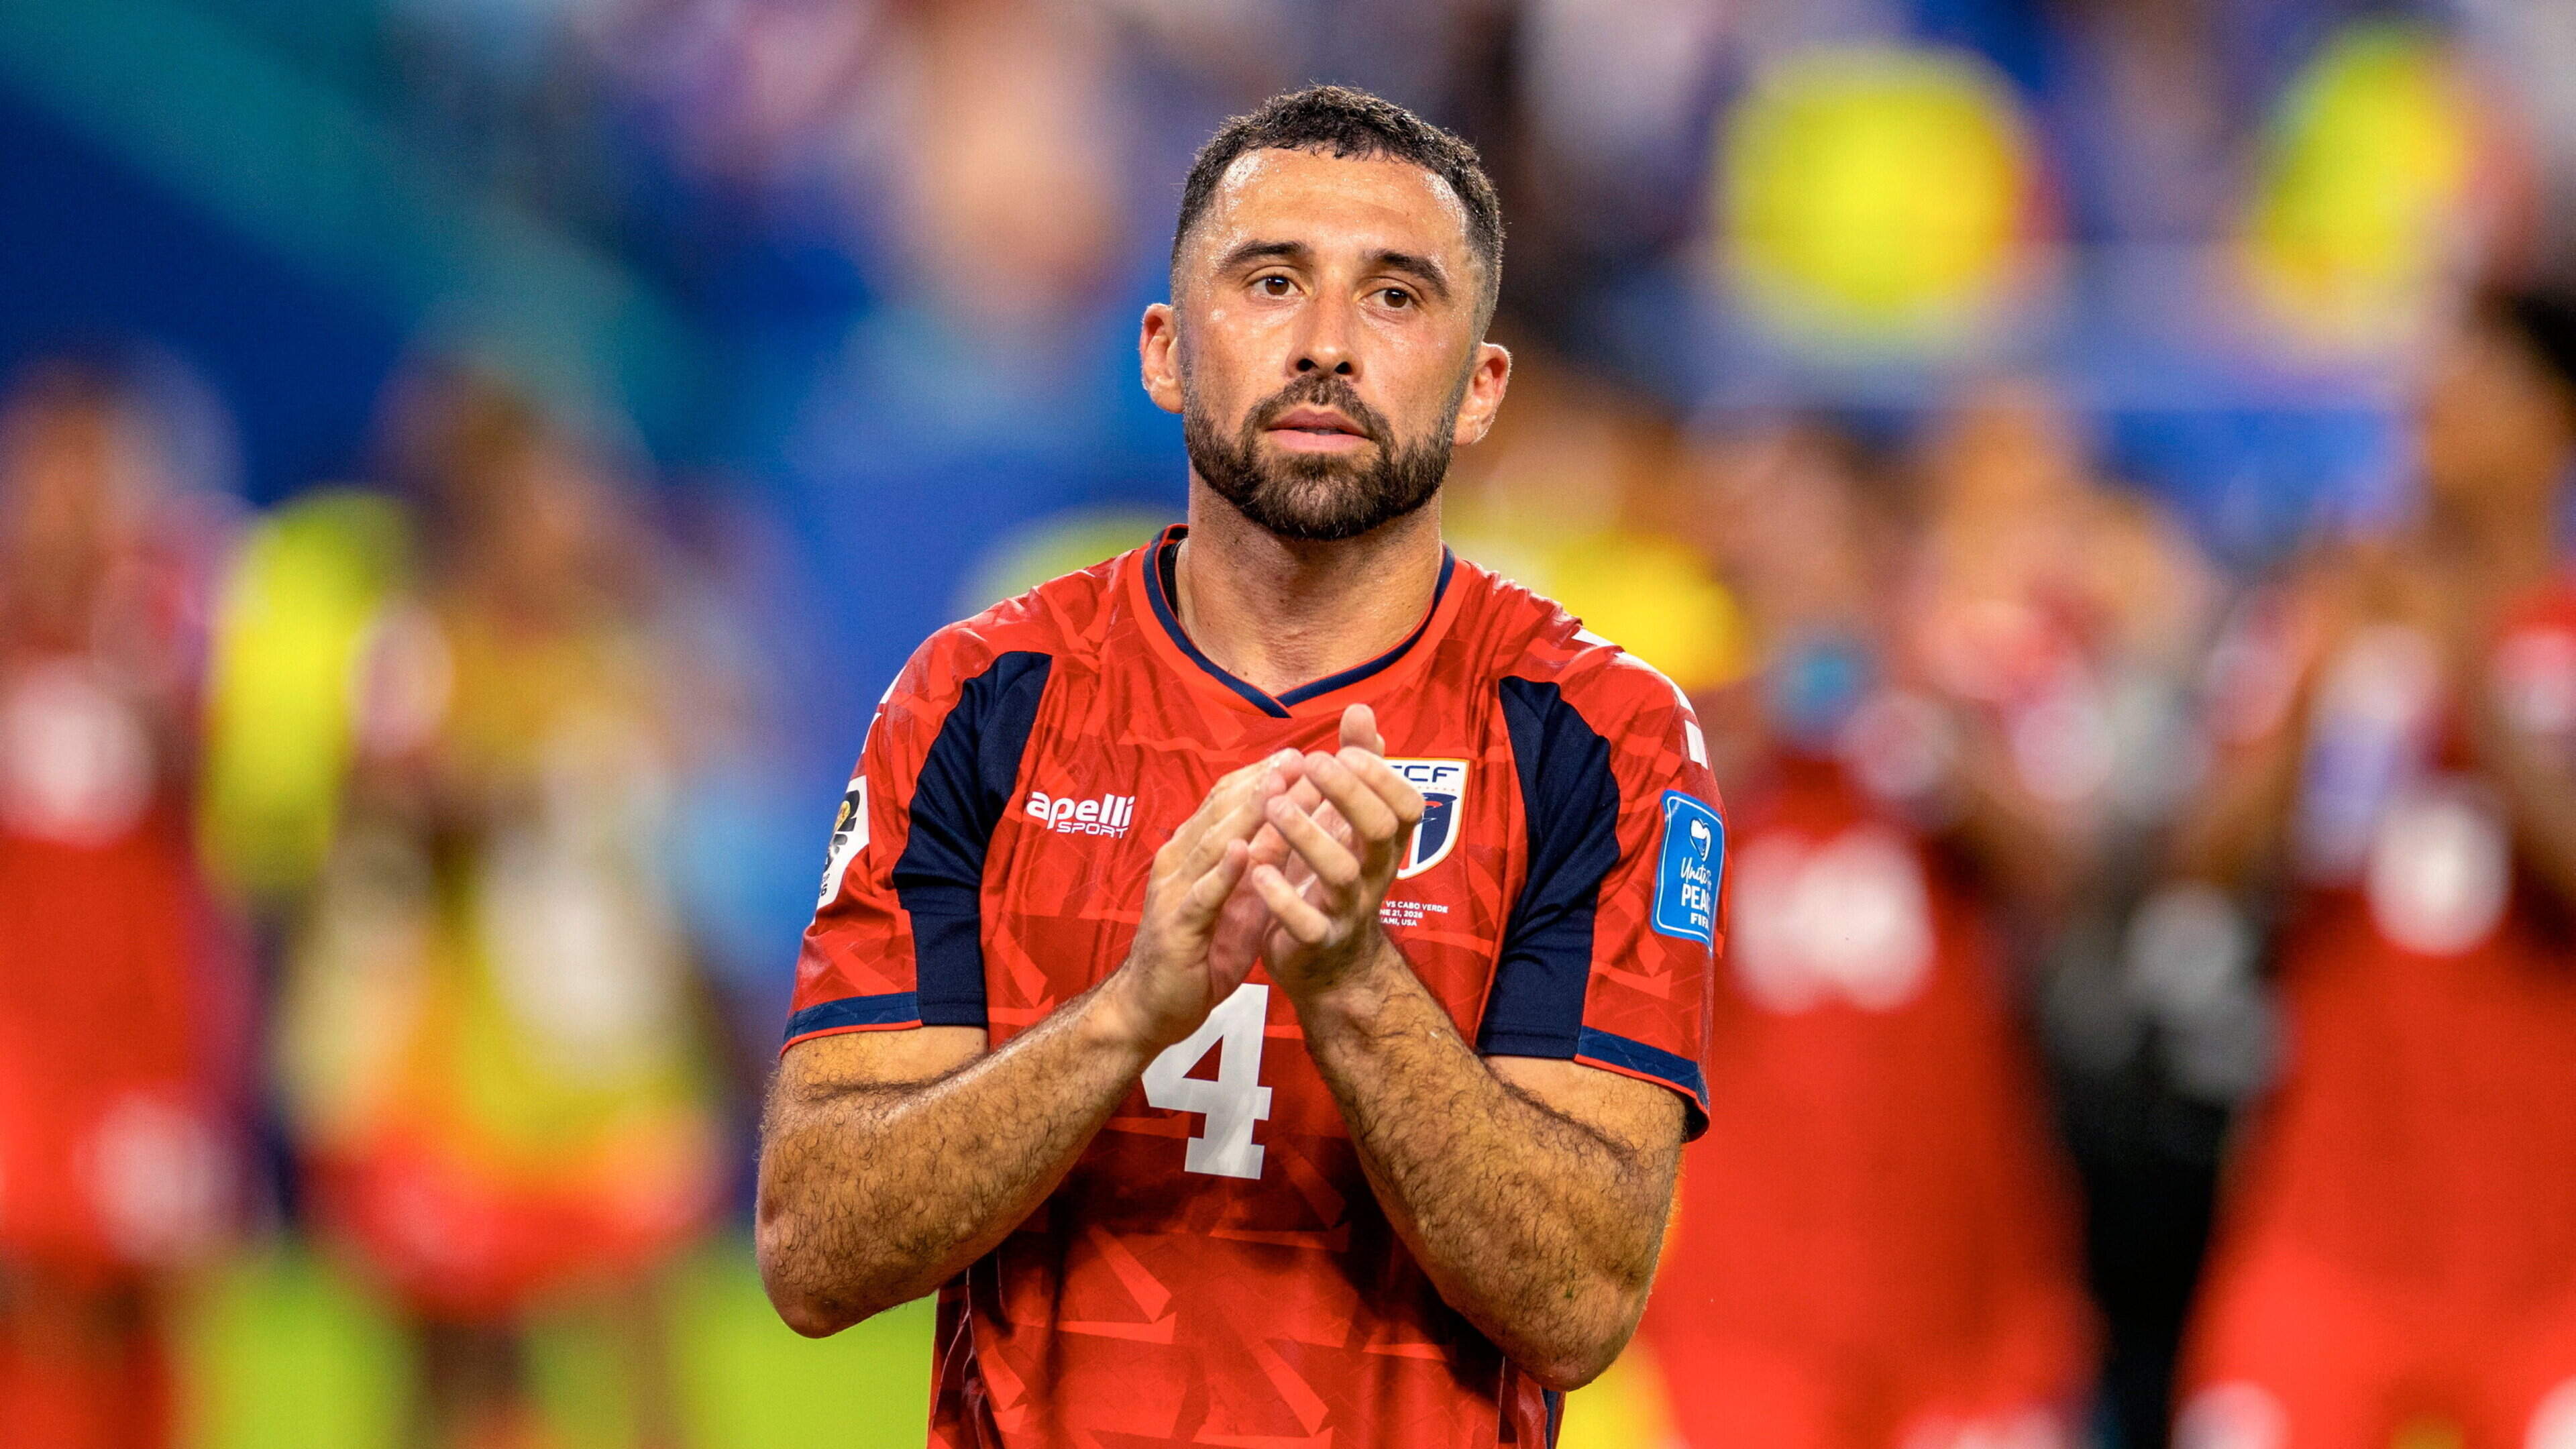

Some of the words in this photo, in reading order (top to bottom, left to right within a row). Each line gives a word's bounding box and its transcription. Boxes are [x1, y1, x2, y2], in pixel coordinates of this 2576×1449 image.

[1391, 765, 1459, 783] CF
[1026, 792, 1135, 829] apelli
[1057, 822, 1128, 839] SPORT
[1397, 902, 1420, 910] CABO
[1422, 904, 1448, 913] VERDE
[1680, 883, 1710, 914] PEA
[1403, 910, 1423, 918] 2026
[1141, 983, 1272, 1179] 4
